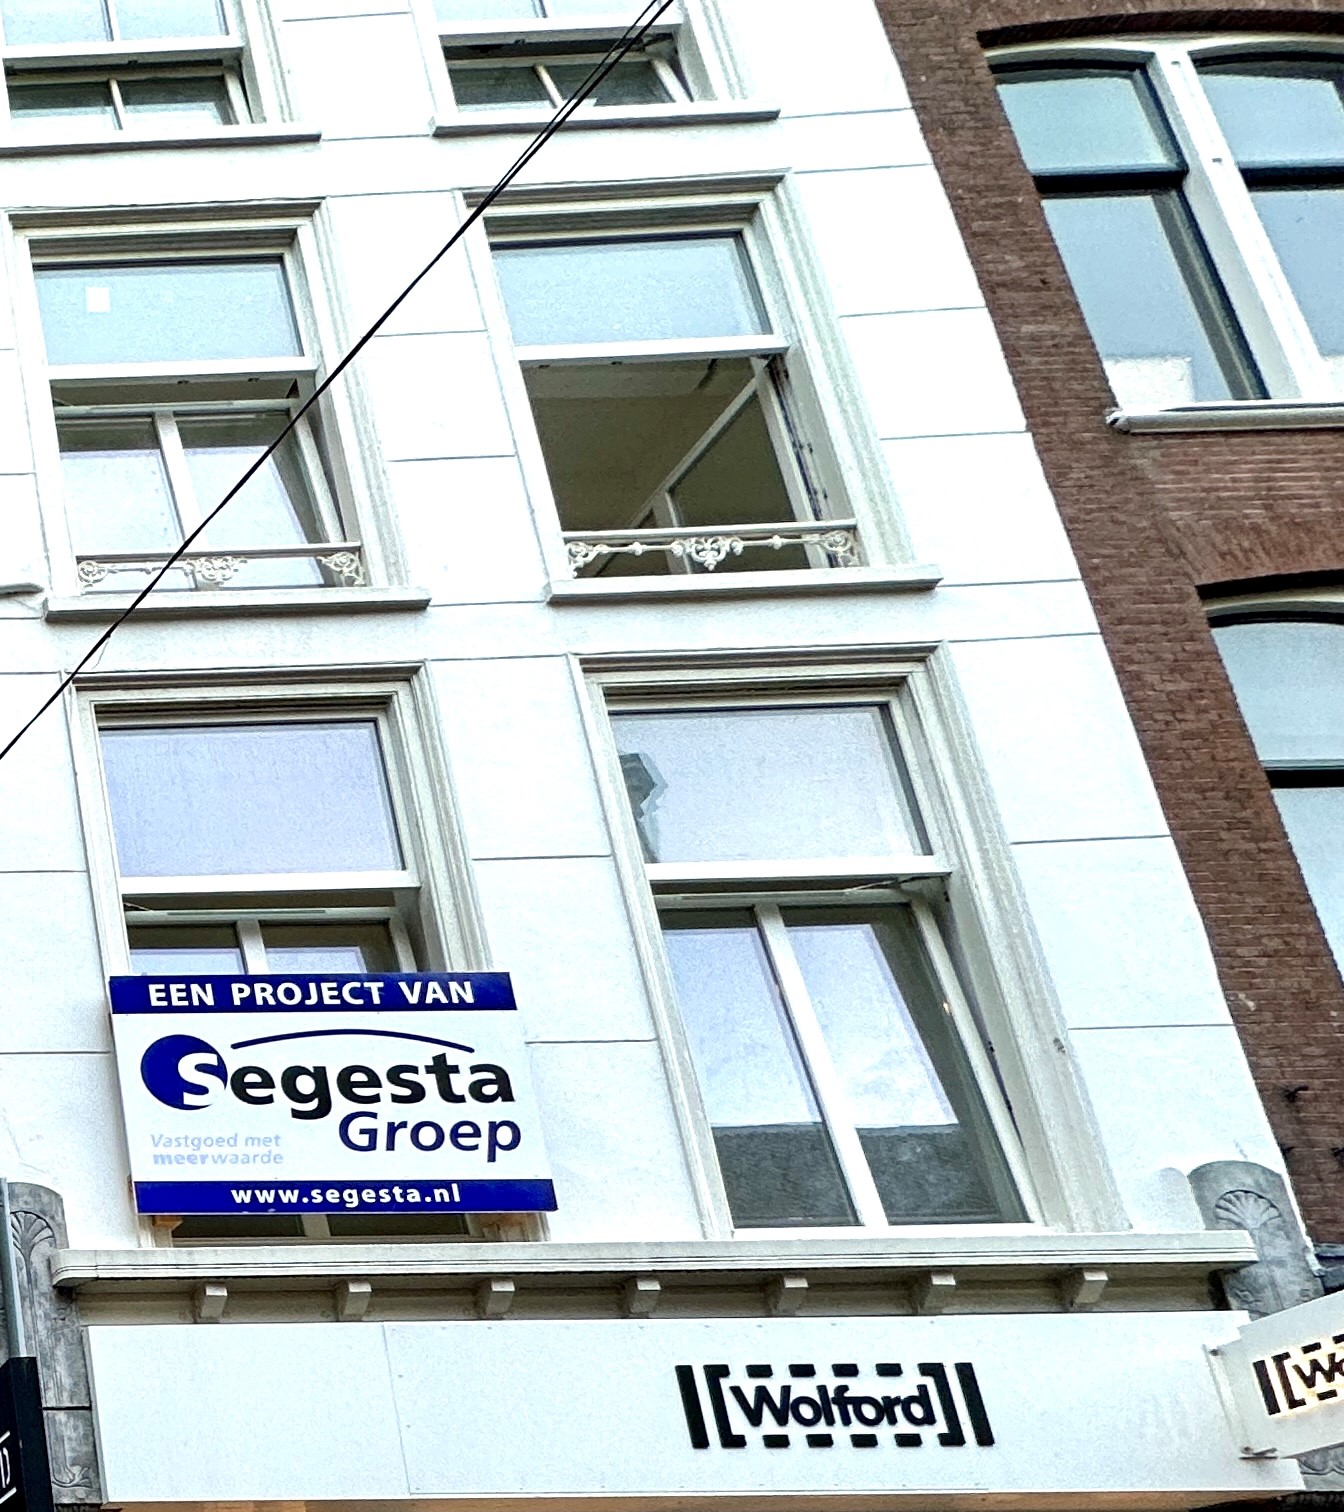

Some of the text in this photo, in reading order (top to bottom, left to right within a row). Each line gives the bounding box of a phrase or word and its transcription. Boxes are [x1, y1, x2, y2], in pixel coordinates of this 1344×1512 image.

[148, 981, 475, 1007] EEN PROJECT VAN
[178, 1051, 515, 1120] Segesta
[151, 1133, 281, 1151] Vastgoed met
[338, 1111, 521, 1163] Groep
[153, 1149, 284, 1165] meerwaarde
[231, 1184, 461, 1208] www.segesta.nl
[729, 1384, 937, 1427] Wolford
